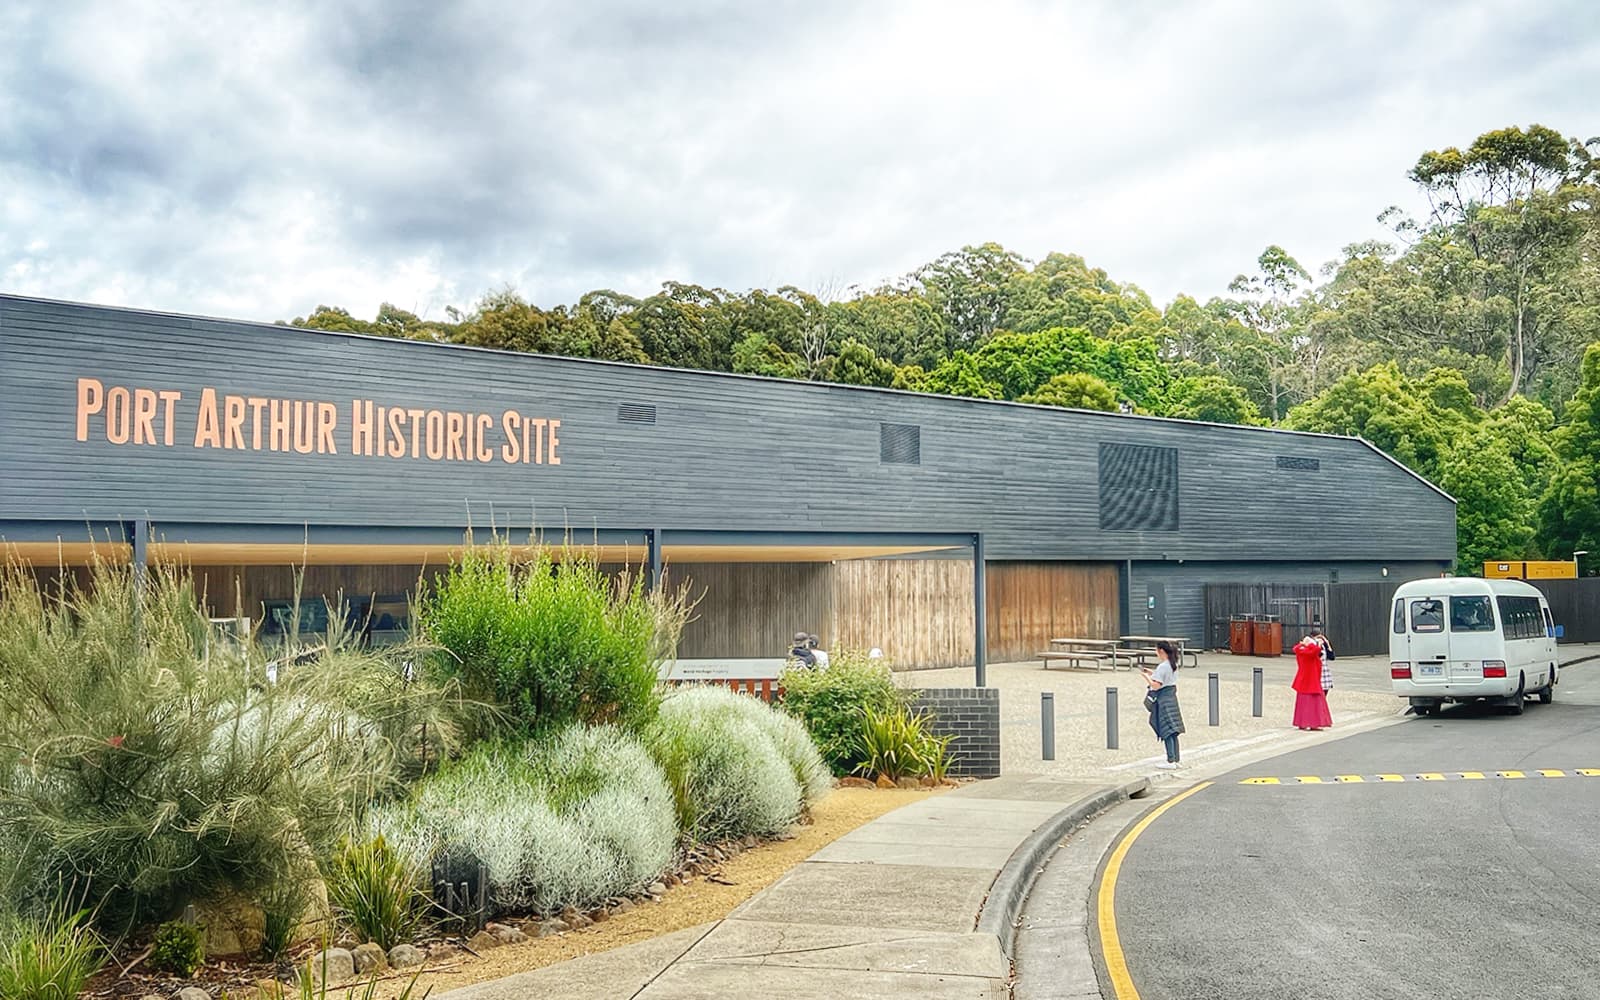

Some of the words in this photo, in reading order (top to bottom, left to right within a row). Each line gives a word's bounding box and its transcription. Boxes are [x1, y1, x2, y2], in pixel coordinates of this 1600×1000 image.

[76, 378, 181, 446] PORT
[194, 388, 337, 455] ARTHUR
[352, 399, 493, 463] HISTORIC
[502, 410, 561, 465] SITE
